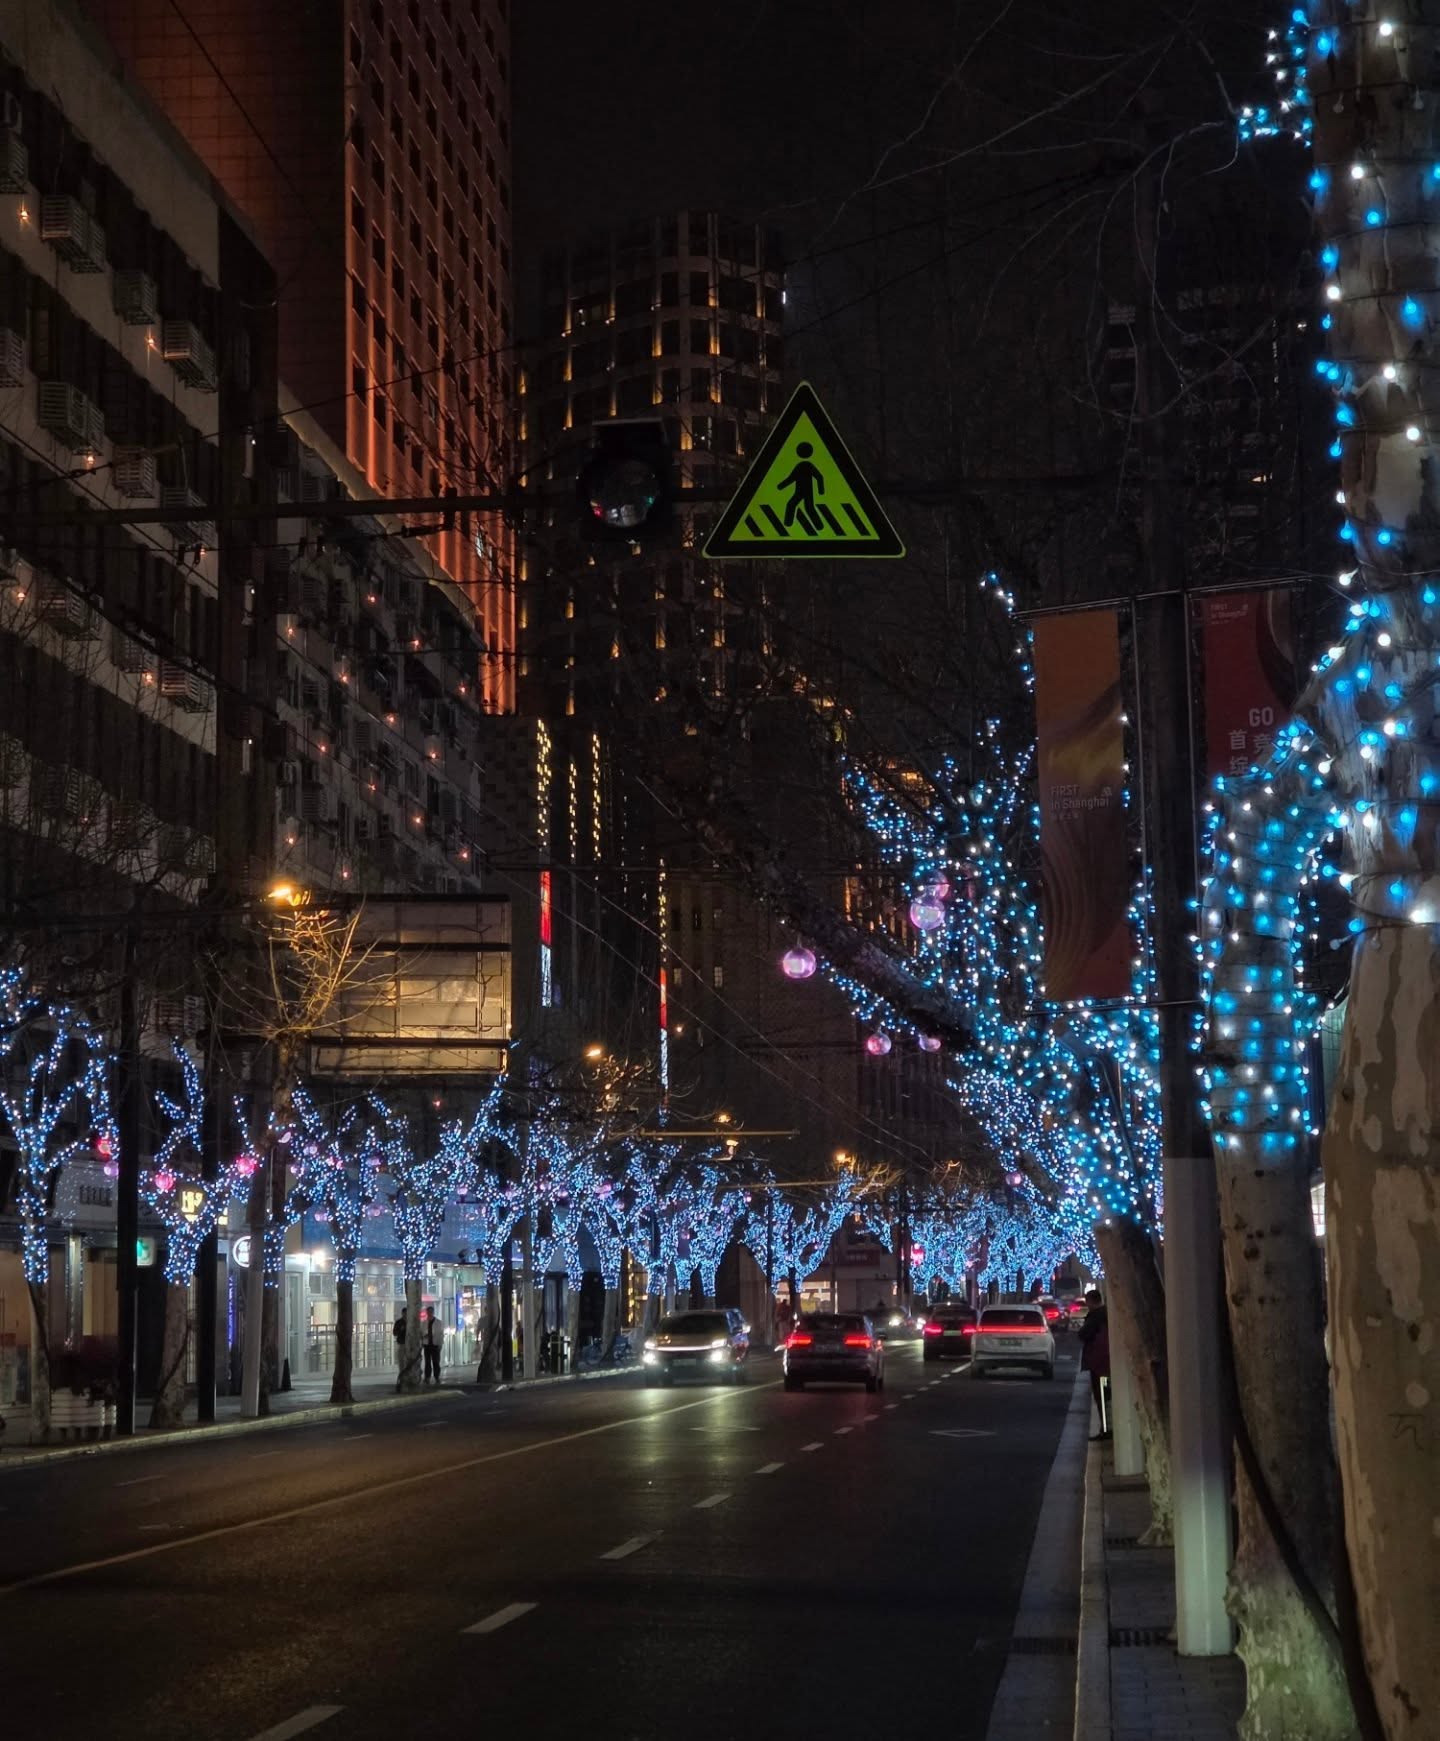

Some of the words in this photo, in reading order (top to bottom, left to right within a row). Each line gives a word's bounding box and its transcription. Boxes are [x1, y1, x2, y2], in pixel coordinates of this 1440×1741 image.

[1248, 706, 1274, 727] GO
[1050, 784, 1079, 796] FIRST
[1062, 796, 1109, 811] Shanghai
